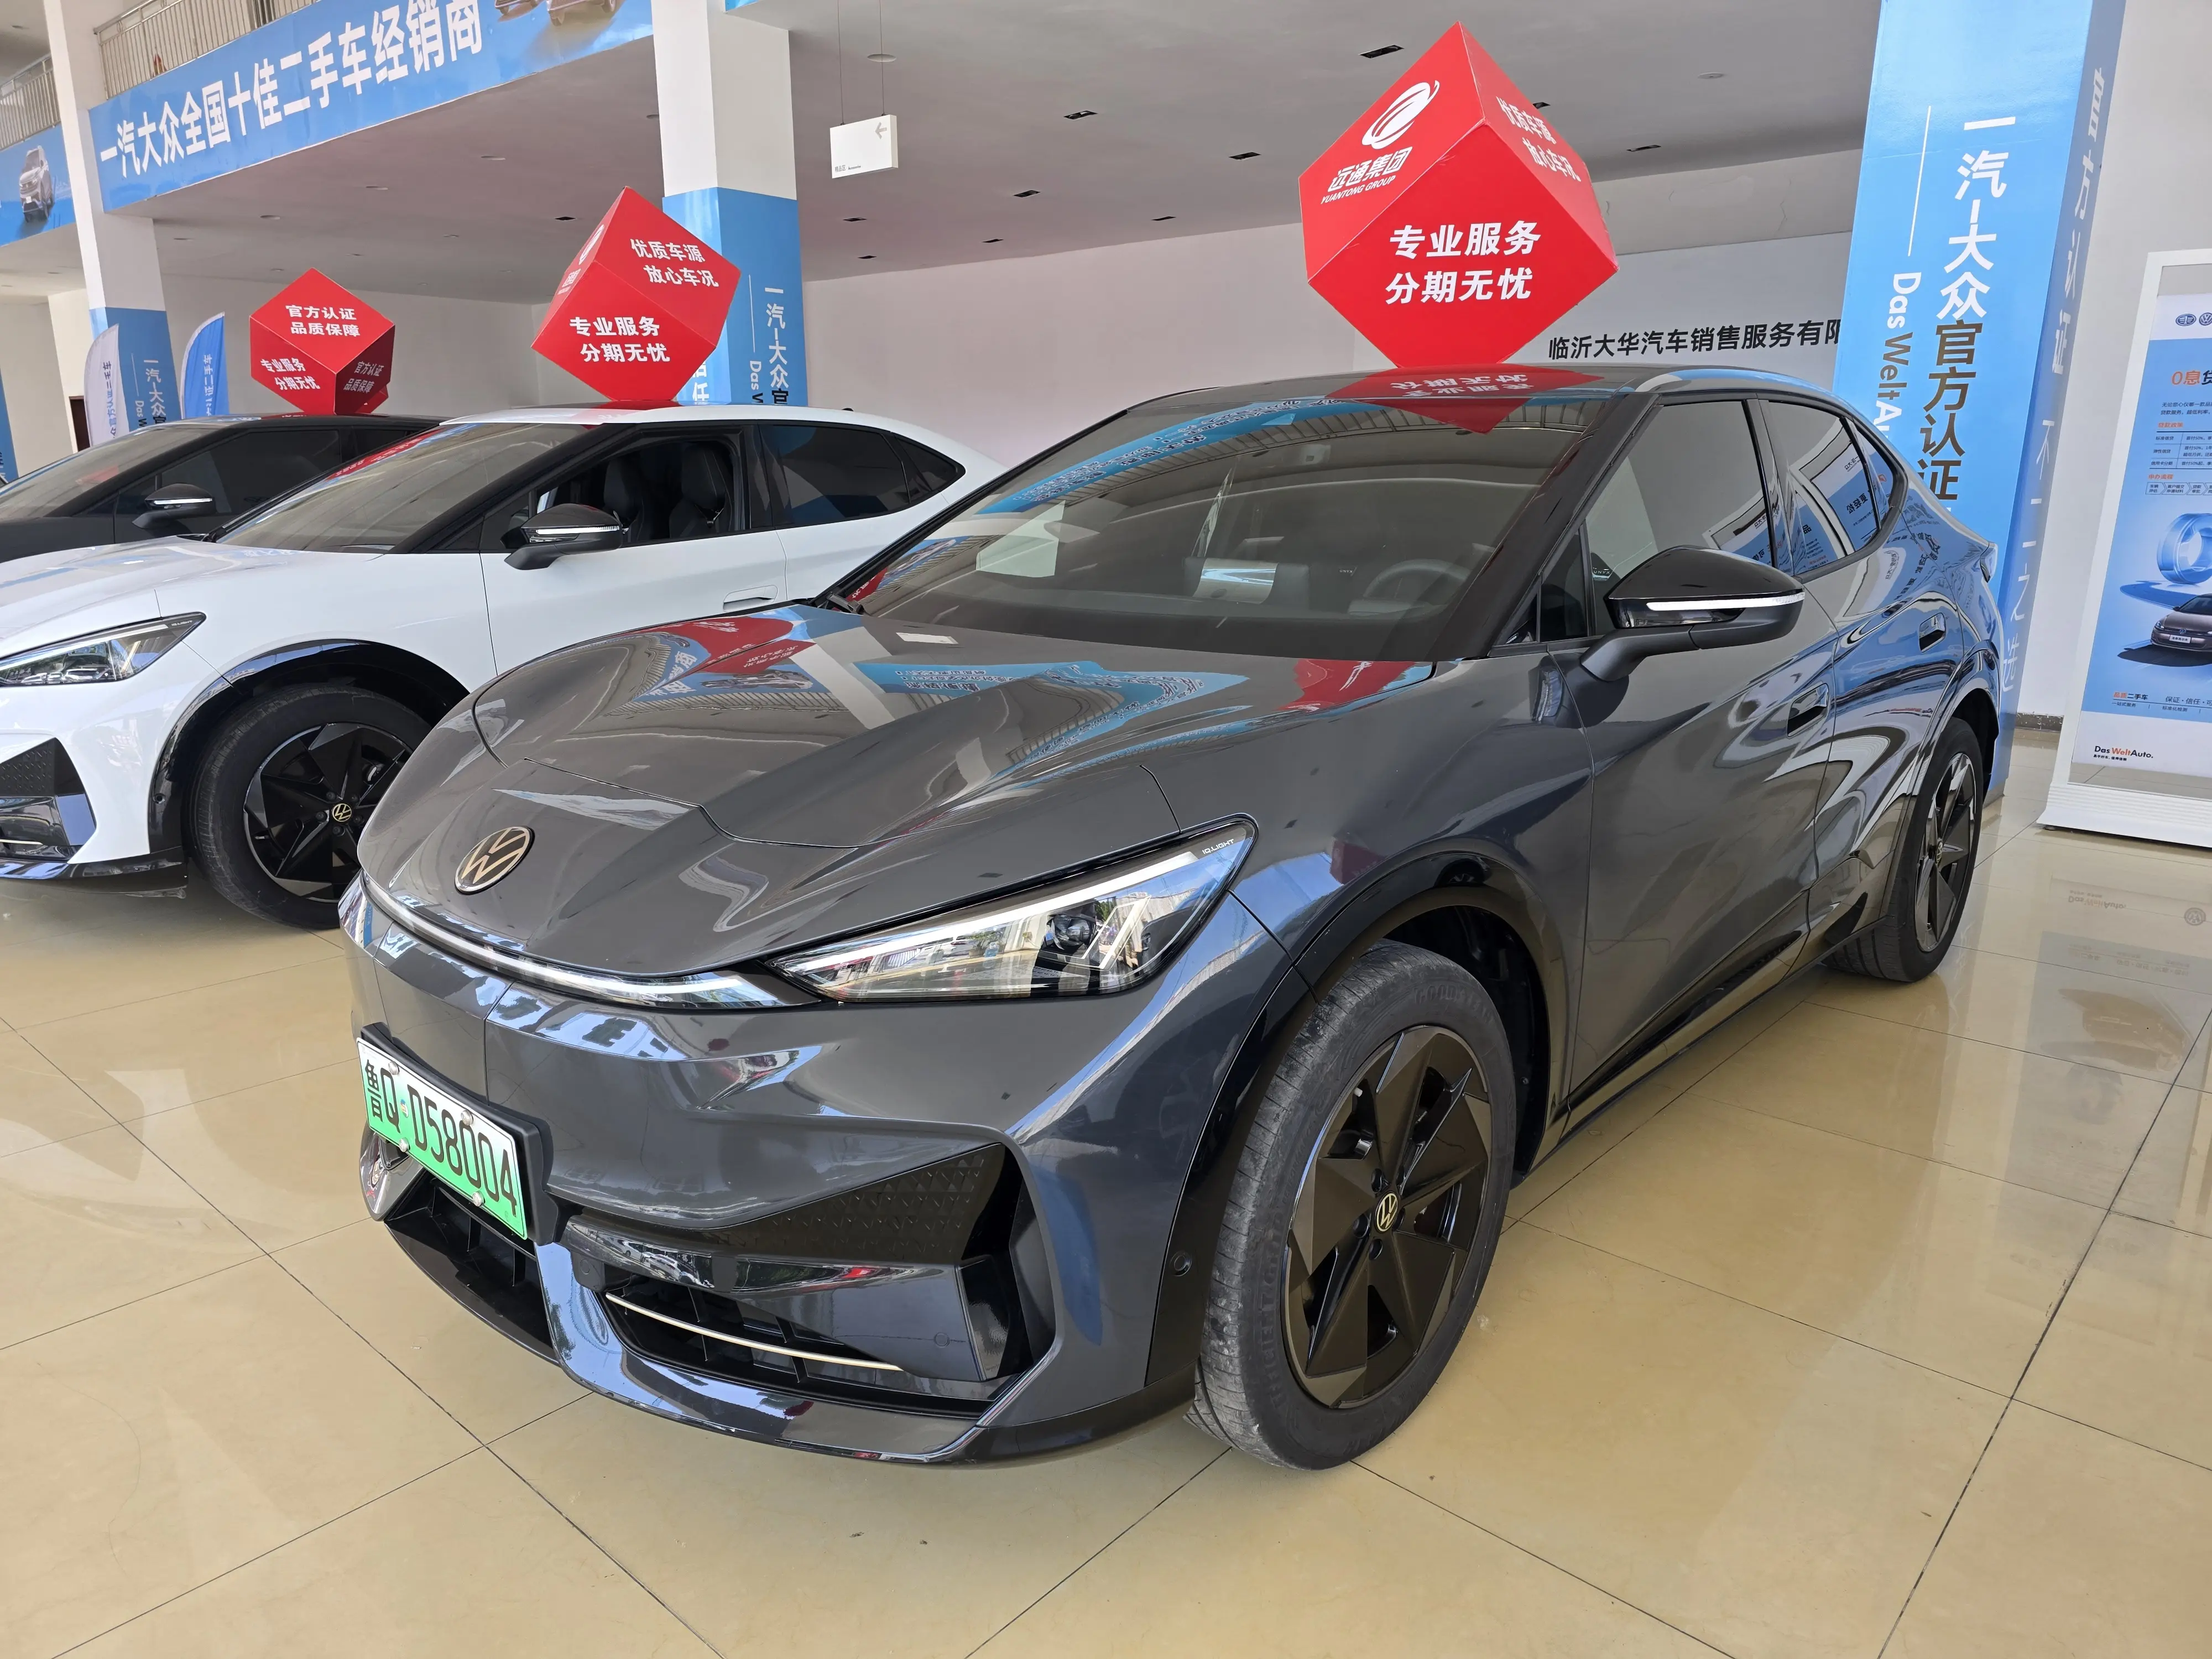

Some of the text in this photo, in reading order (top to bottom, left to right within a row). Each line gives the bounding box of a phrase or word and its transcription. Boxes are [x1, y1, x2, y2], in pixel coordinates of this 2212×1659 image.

[100, 0, 483, 178] 一汽大众全国十佳二手车经销商
[1495, 96, 1556, 144] 优质车源
[1327, 147, 1413, 192] 远通集团
[1521, 138, 1581, 182] 放心车况
[1321, 175, 1396, 205] YUANTONG GROUP
[630, 238, 705, 263] 优质车源
[1389, 221, 1541, 259] 专业服务
[644, 265, 719, 287] 放心车况
[1385, 267, 1533, 305] 分期无忧
[1887, 272, 1922, 329] Das
[285, 305, 357, 320] 官方认证
[290, 322, 361, 337] 品质保障
[569, 316, 660, 337] 专业服务
[580, 342, 670, 362] 分期无忧
[260, 358, 306, 373] 专业服务
[354, 361, 384, 377] 官方认证
[750, 361, 761, 390] Das
[274, 376, 320, 390] 分期无忧
[343, 378, 374, 393] 品质保障
[2114, 692, 2148, 700] 品质二手车
[2094, 745, 2110, 754] Das
[1202, 838, 1234, 855] IQ.LIGHT
